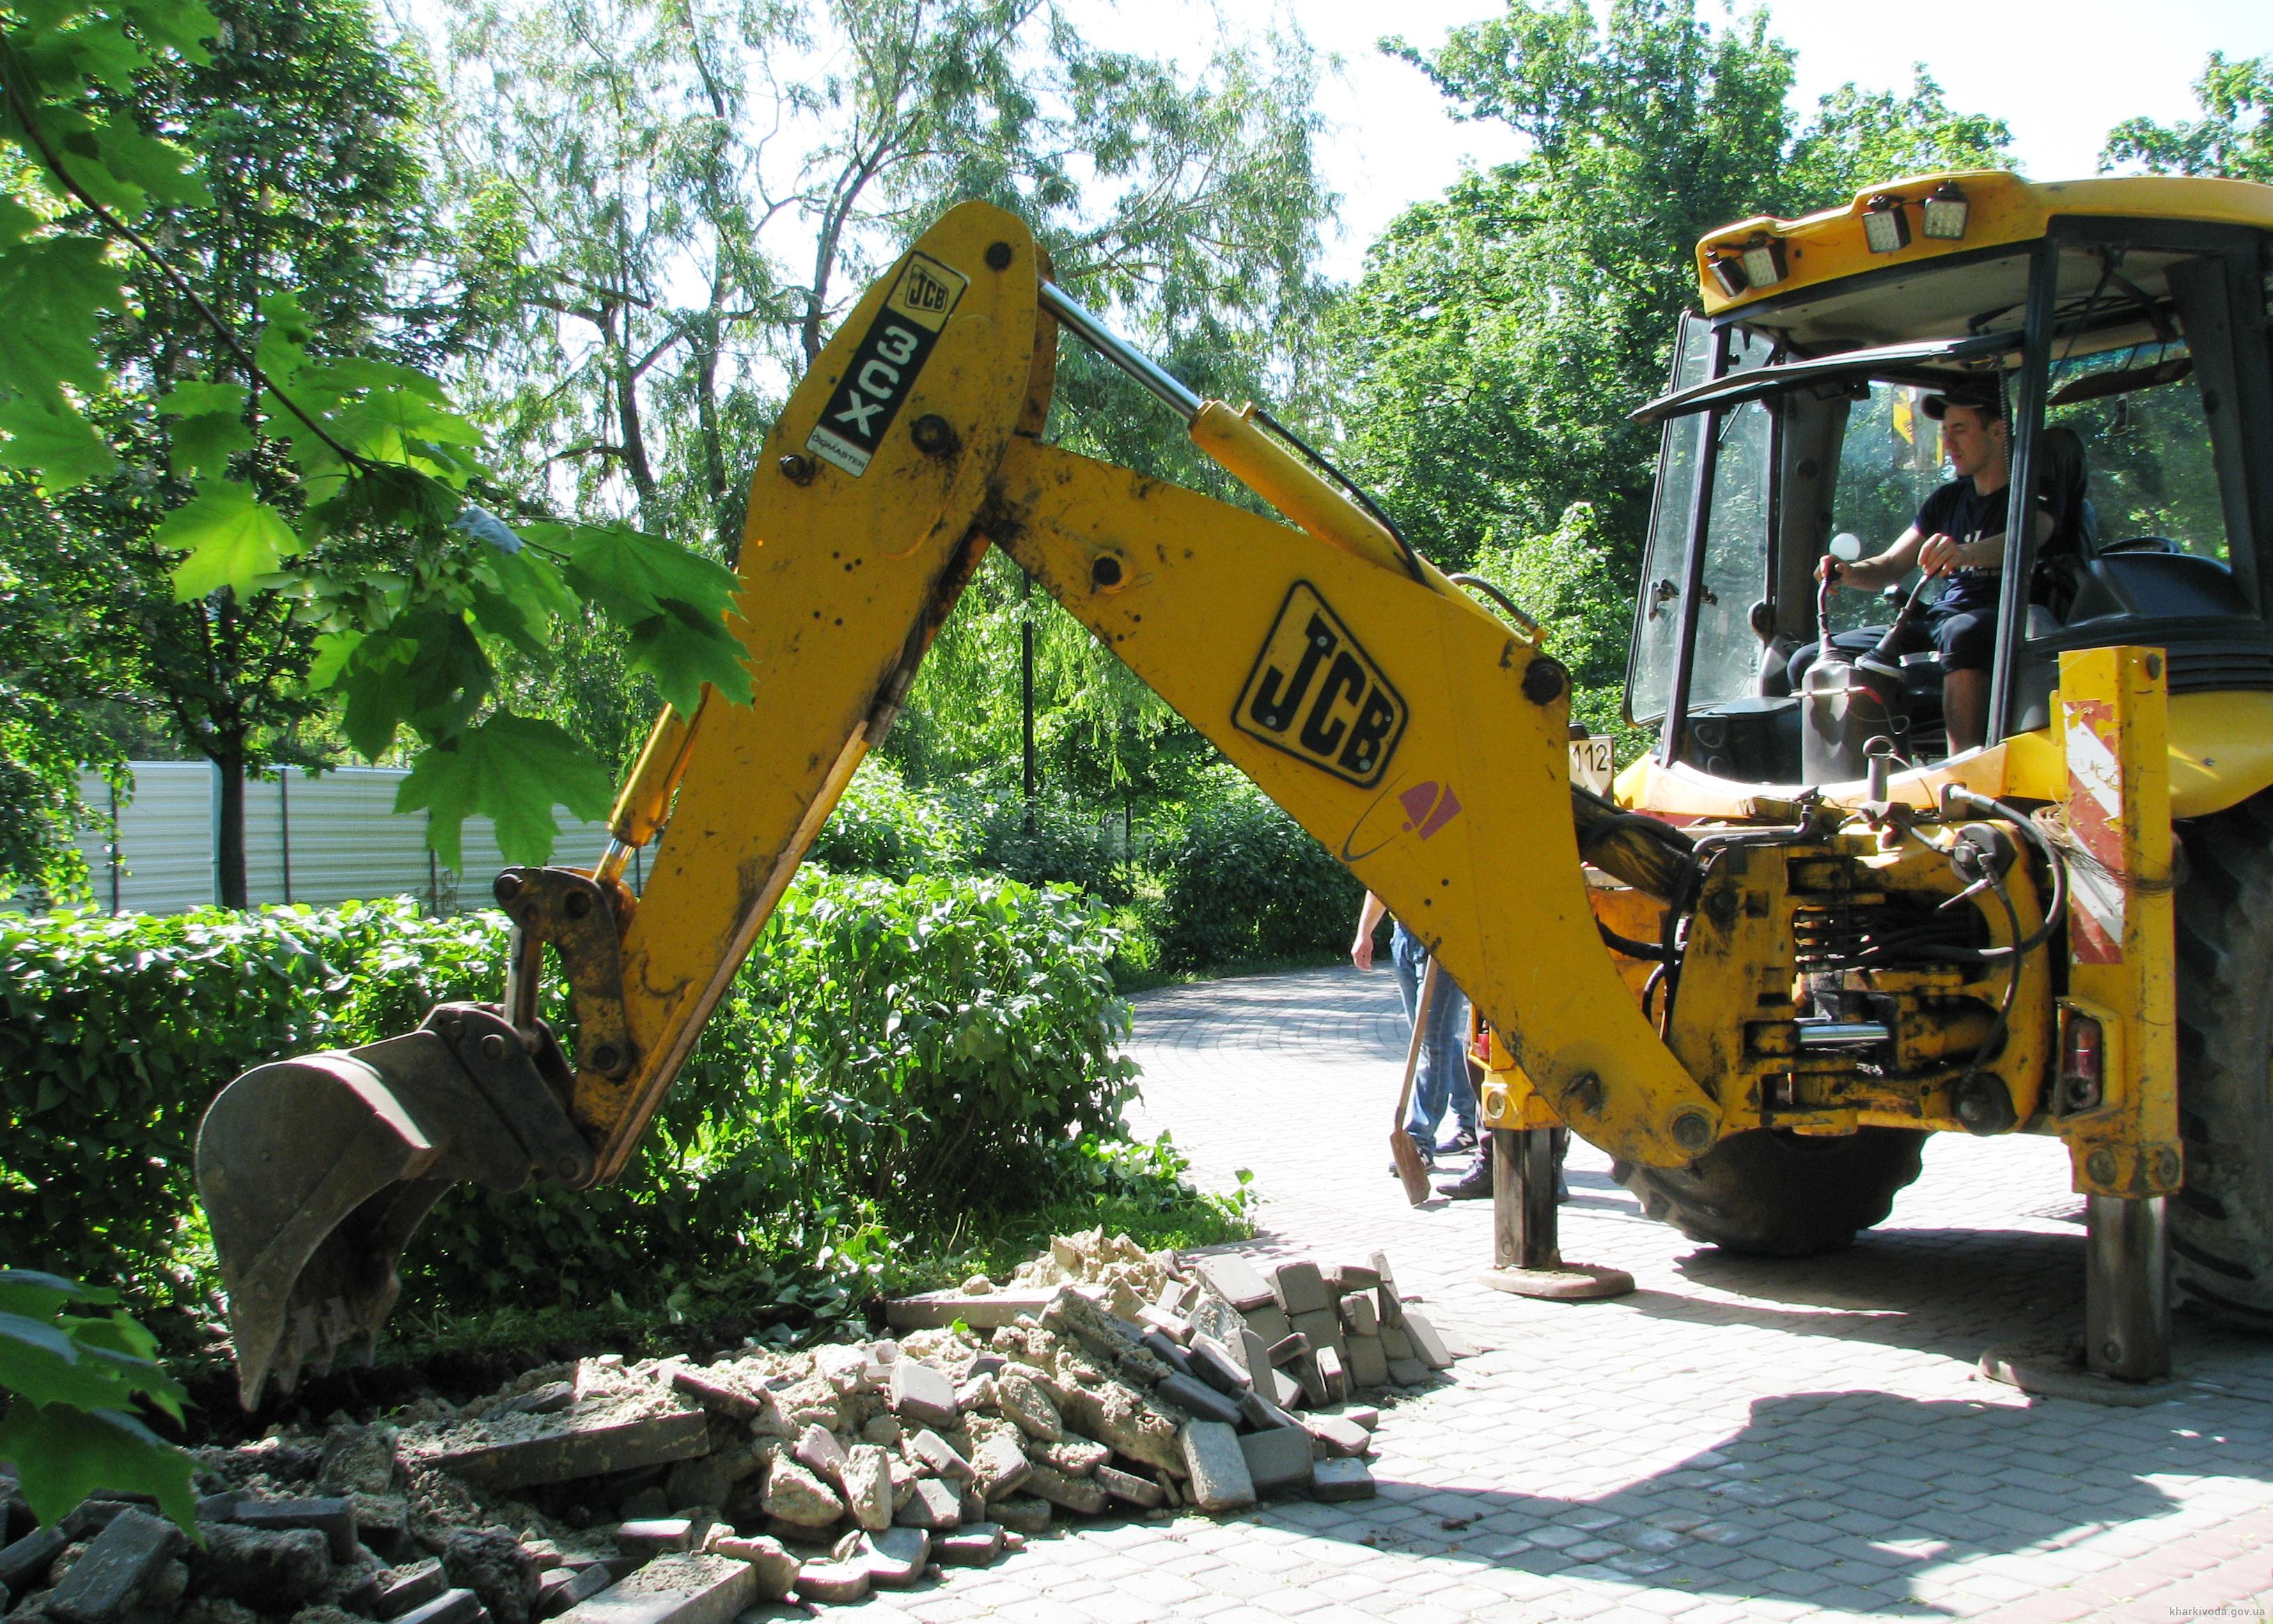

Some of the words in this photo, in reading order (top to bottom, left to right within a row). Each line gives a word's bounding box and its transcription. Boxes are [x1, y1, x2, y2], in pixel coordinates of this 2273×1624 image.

[909, 272, 948, 310] JCB
[834, 325, 919, 437] 3CX
[1250, 611, 1395, 774] JCB
[1572, 744, 1607, 772] 112
